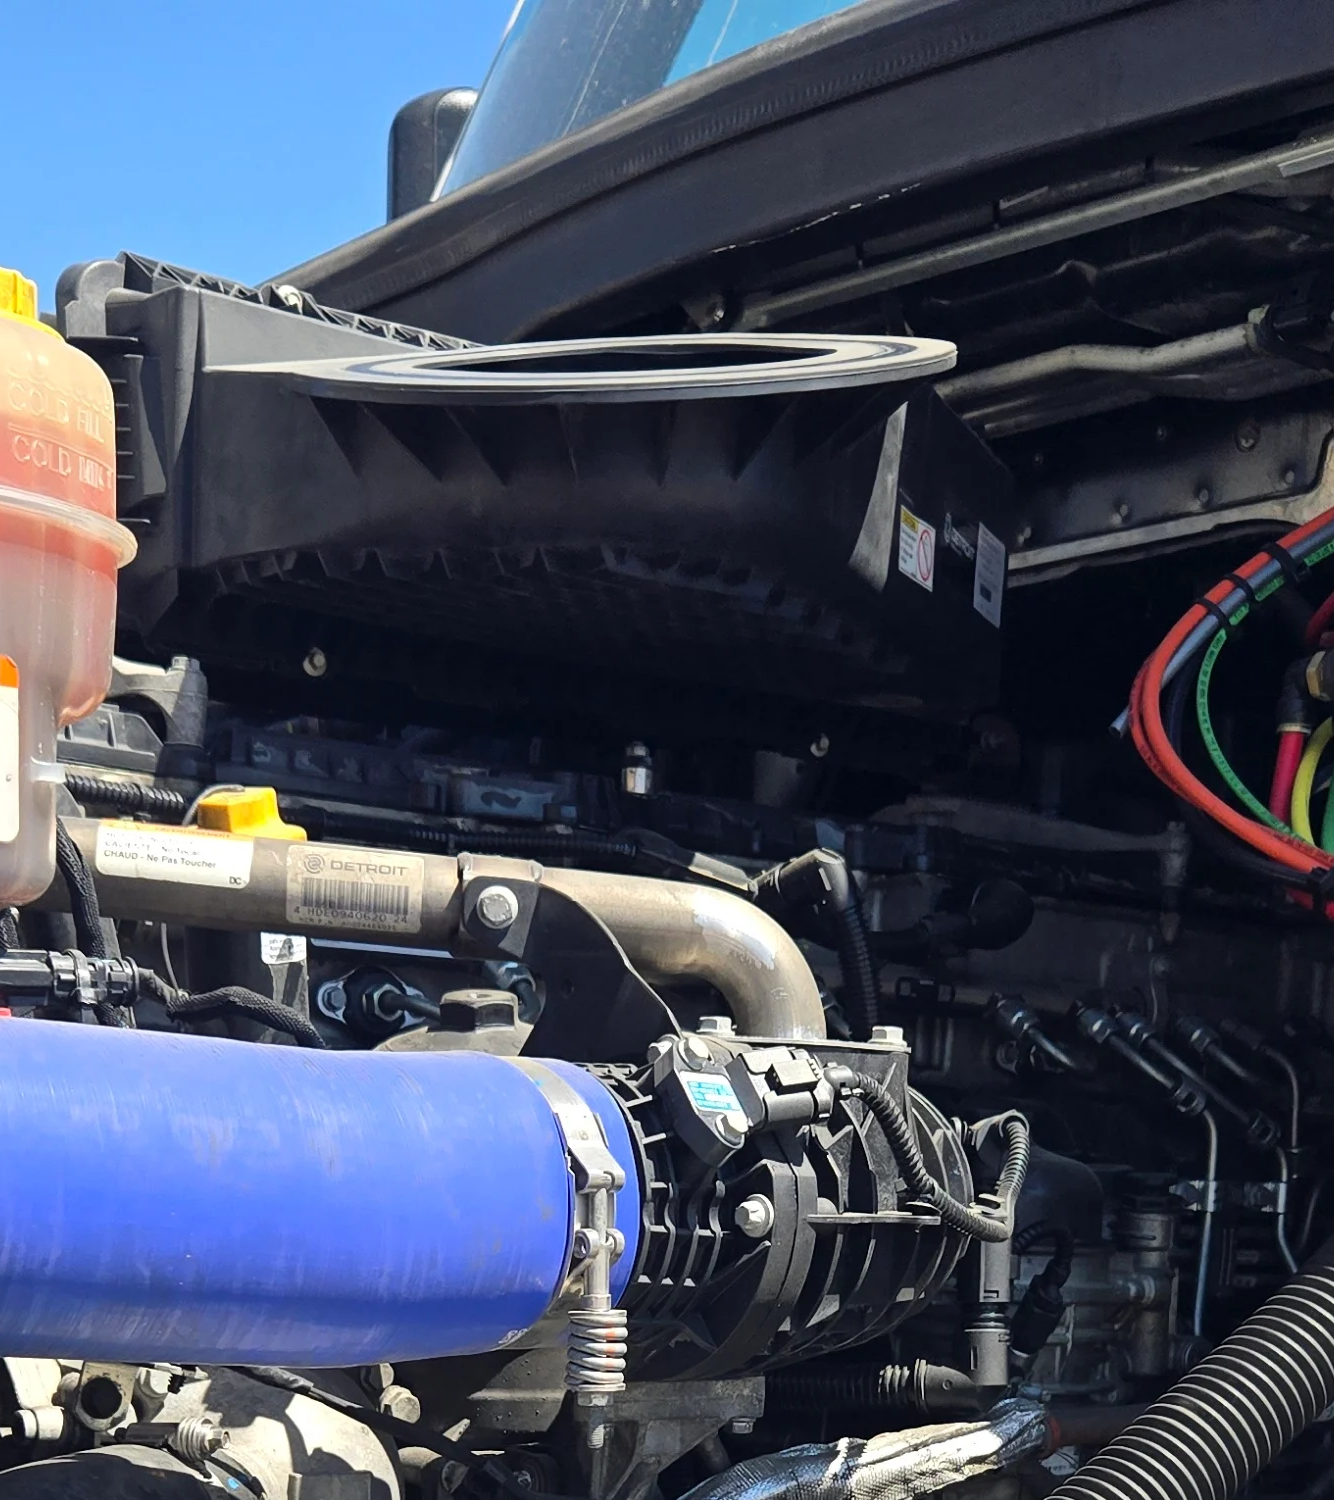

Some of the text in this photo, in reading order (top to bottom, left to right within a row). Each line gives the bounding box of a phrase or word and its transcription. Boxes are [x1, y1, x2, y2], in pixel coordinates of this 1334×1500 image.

[12, 435, 72, 476] COLD
[104, 850, 138, 860] CHAUD
[147, 854, 158, 862] Ne
[162, 856, 177, 864] Pas
[181, 858, 216, 868] Toucher
[331, 860, 409, 876] DETROIT
[229, 877, 242, 885] DC
